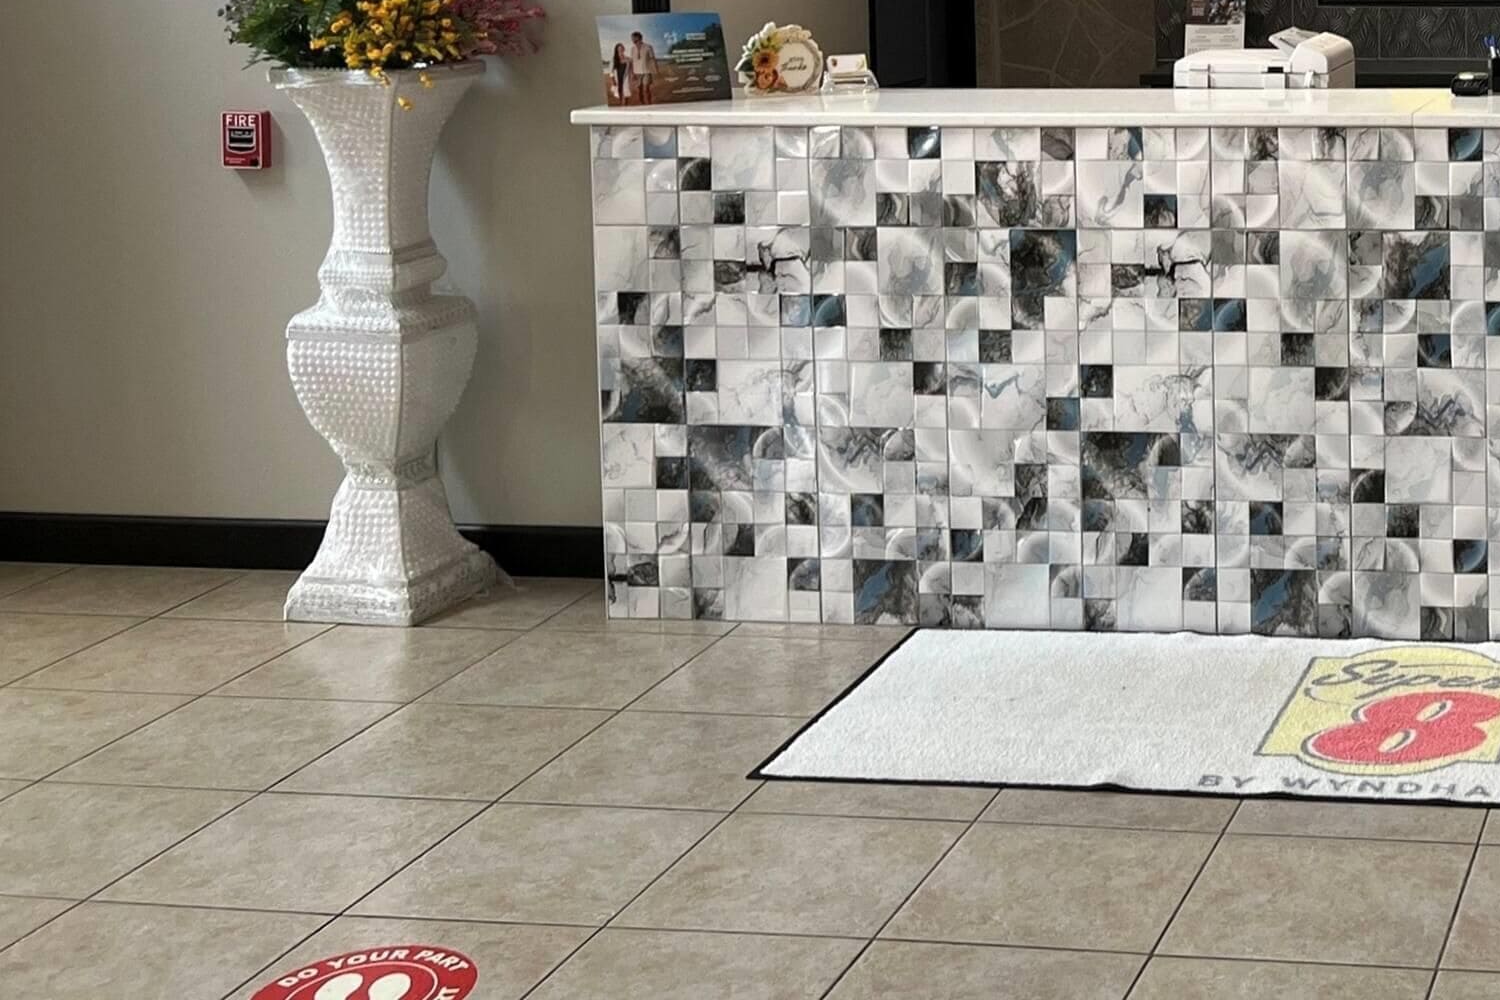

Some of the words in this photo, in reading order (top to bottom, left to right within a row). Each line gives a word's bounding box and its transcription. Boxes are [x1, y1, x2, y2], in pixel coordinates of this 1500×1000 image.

[225, 114, 256, 127] FIRE
[1198, 774, 1254, 790] BY
[277, 967, 319, 988] DO
[326, 949, 410, 969] YOUR
[413, 949, 469, 972] PART
